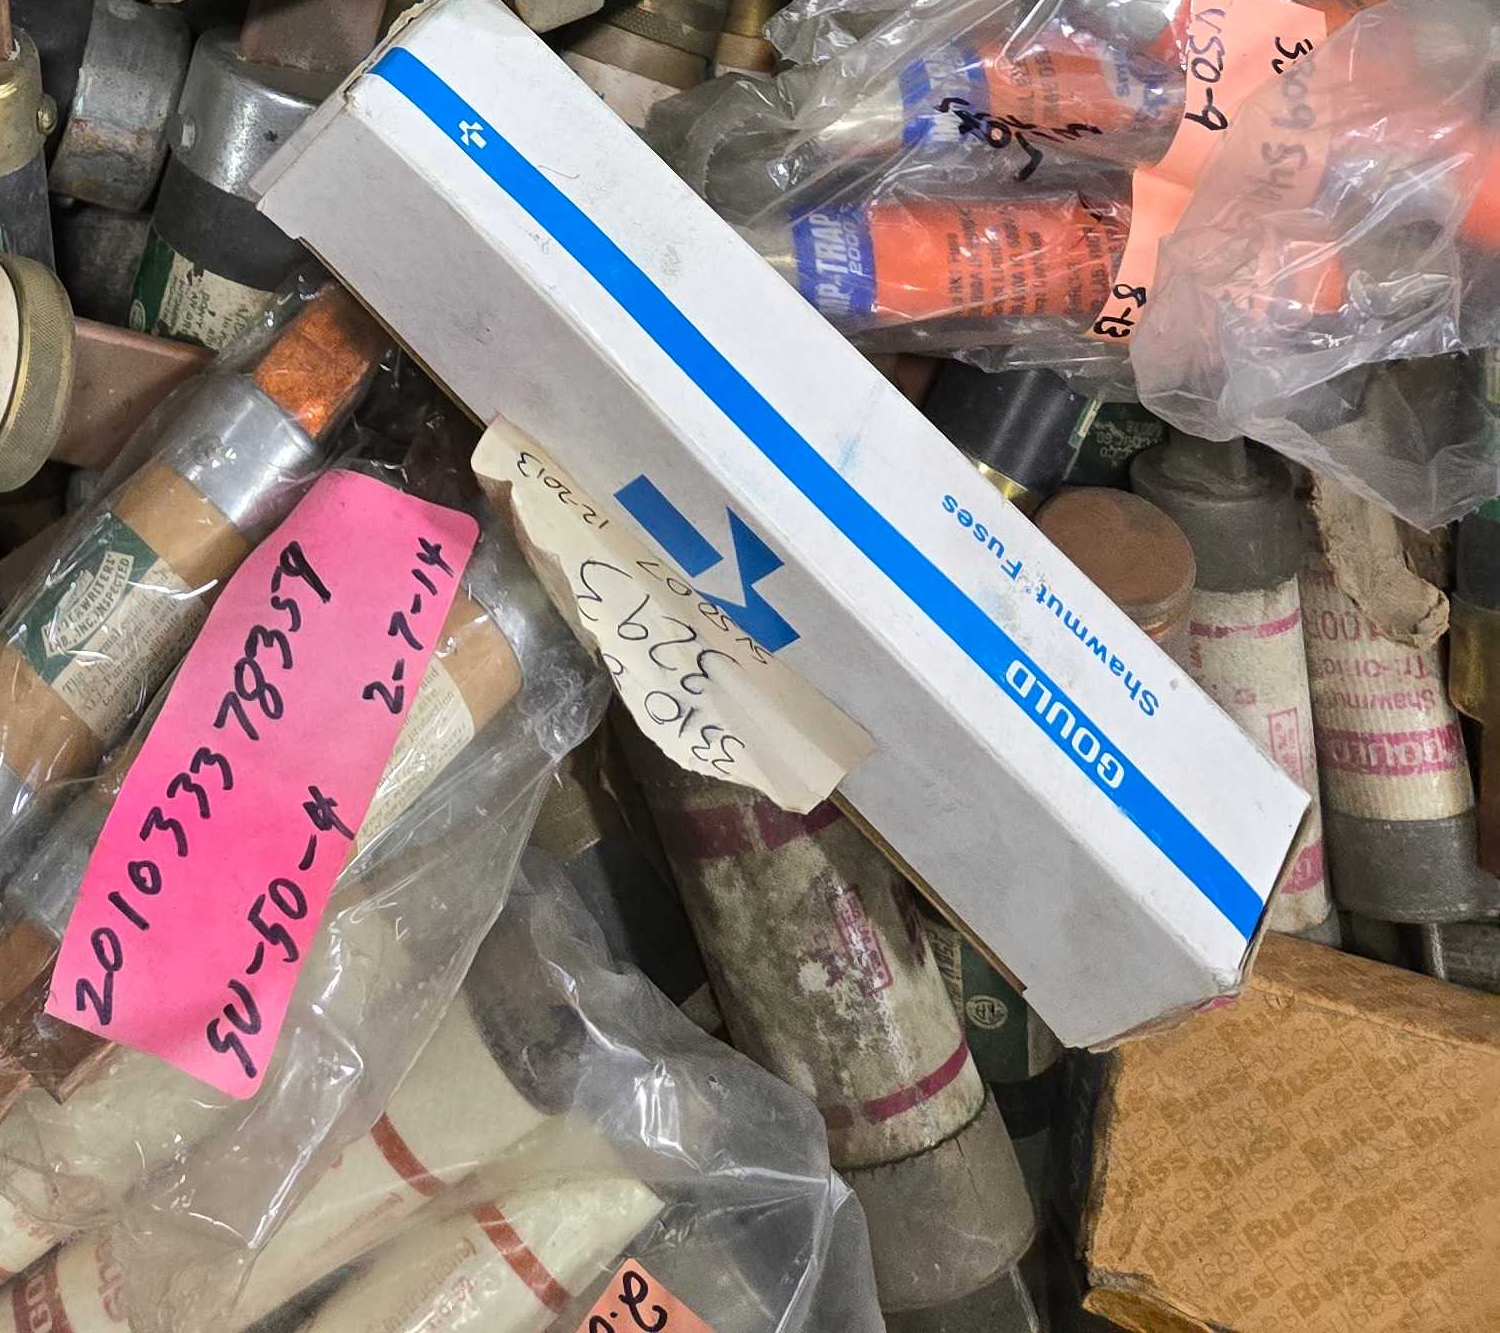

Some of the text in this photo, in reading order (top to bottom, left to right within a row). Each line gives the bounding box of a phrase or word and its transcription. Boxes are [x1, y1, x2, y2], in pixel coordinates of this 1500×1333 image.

[804, 204, 856, 312] MP-TRAP
[942, 493, 1022, 582] Fuses
[551, 549, 751, 709] 3293
[1004, 658, 1126, 791] GOULD
[1322, 683, 1435, 714] Shawmu
